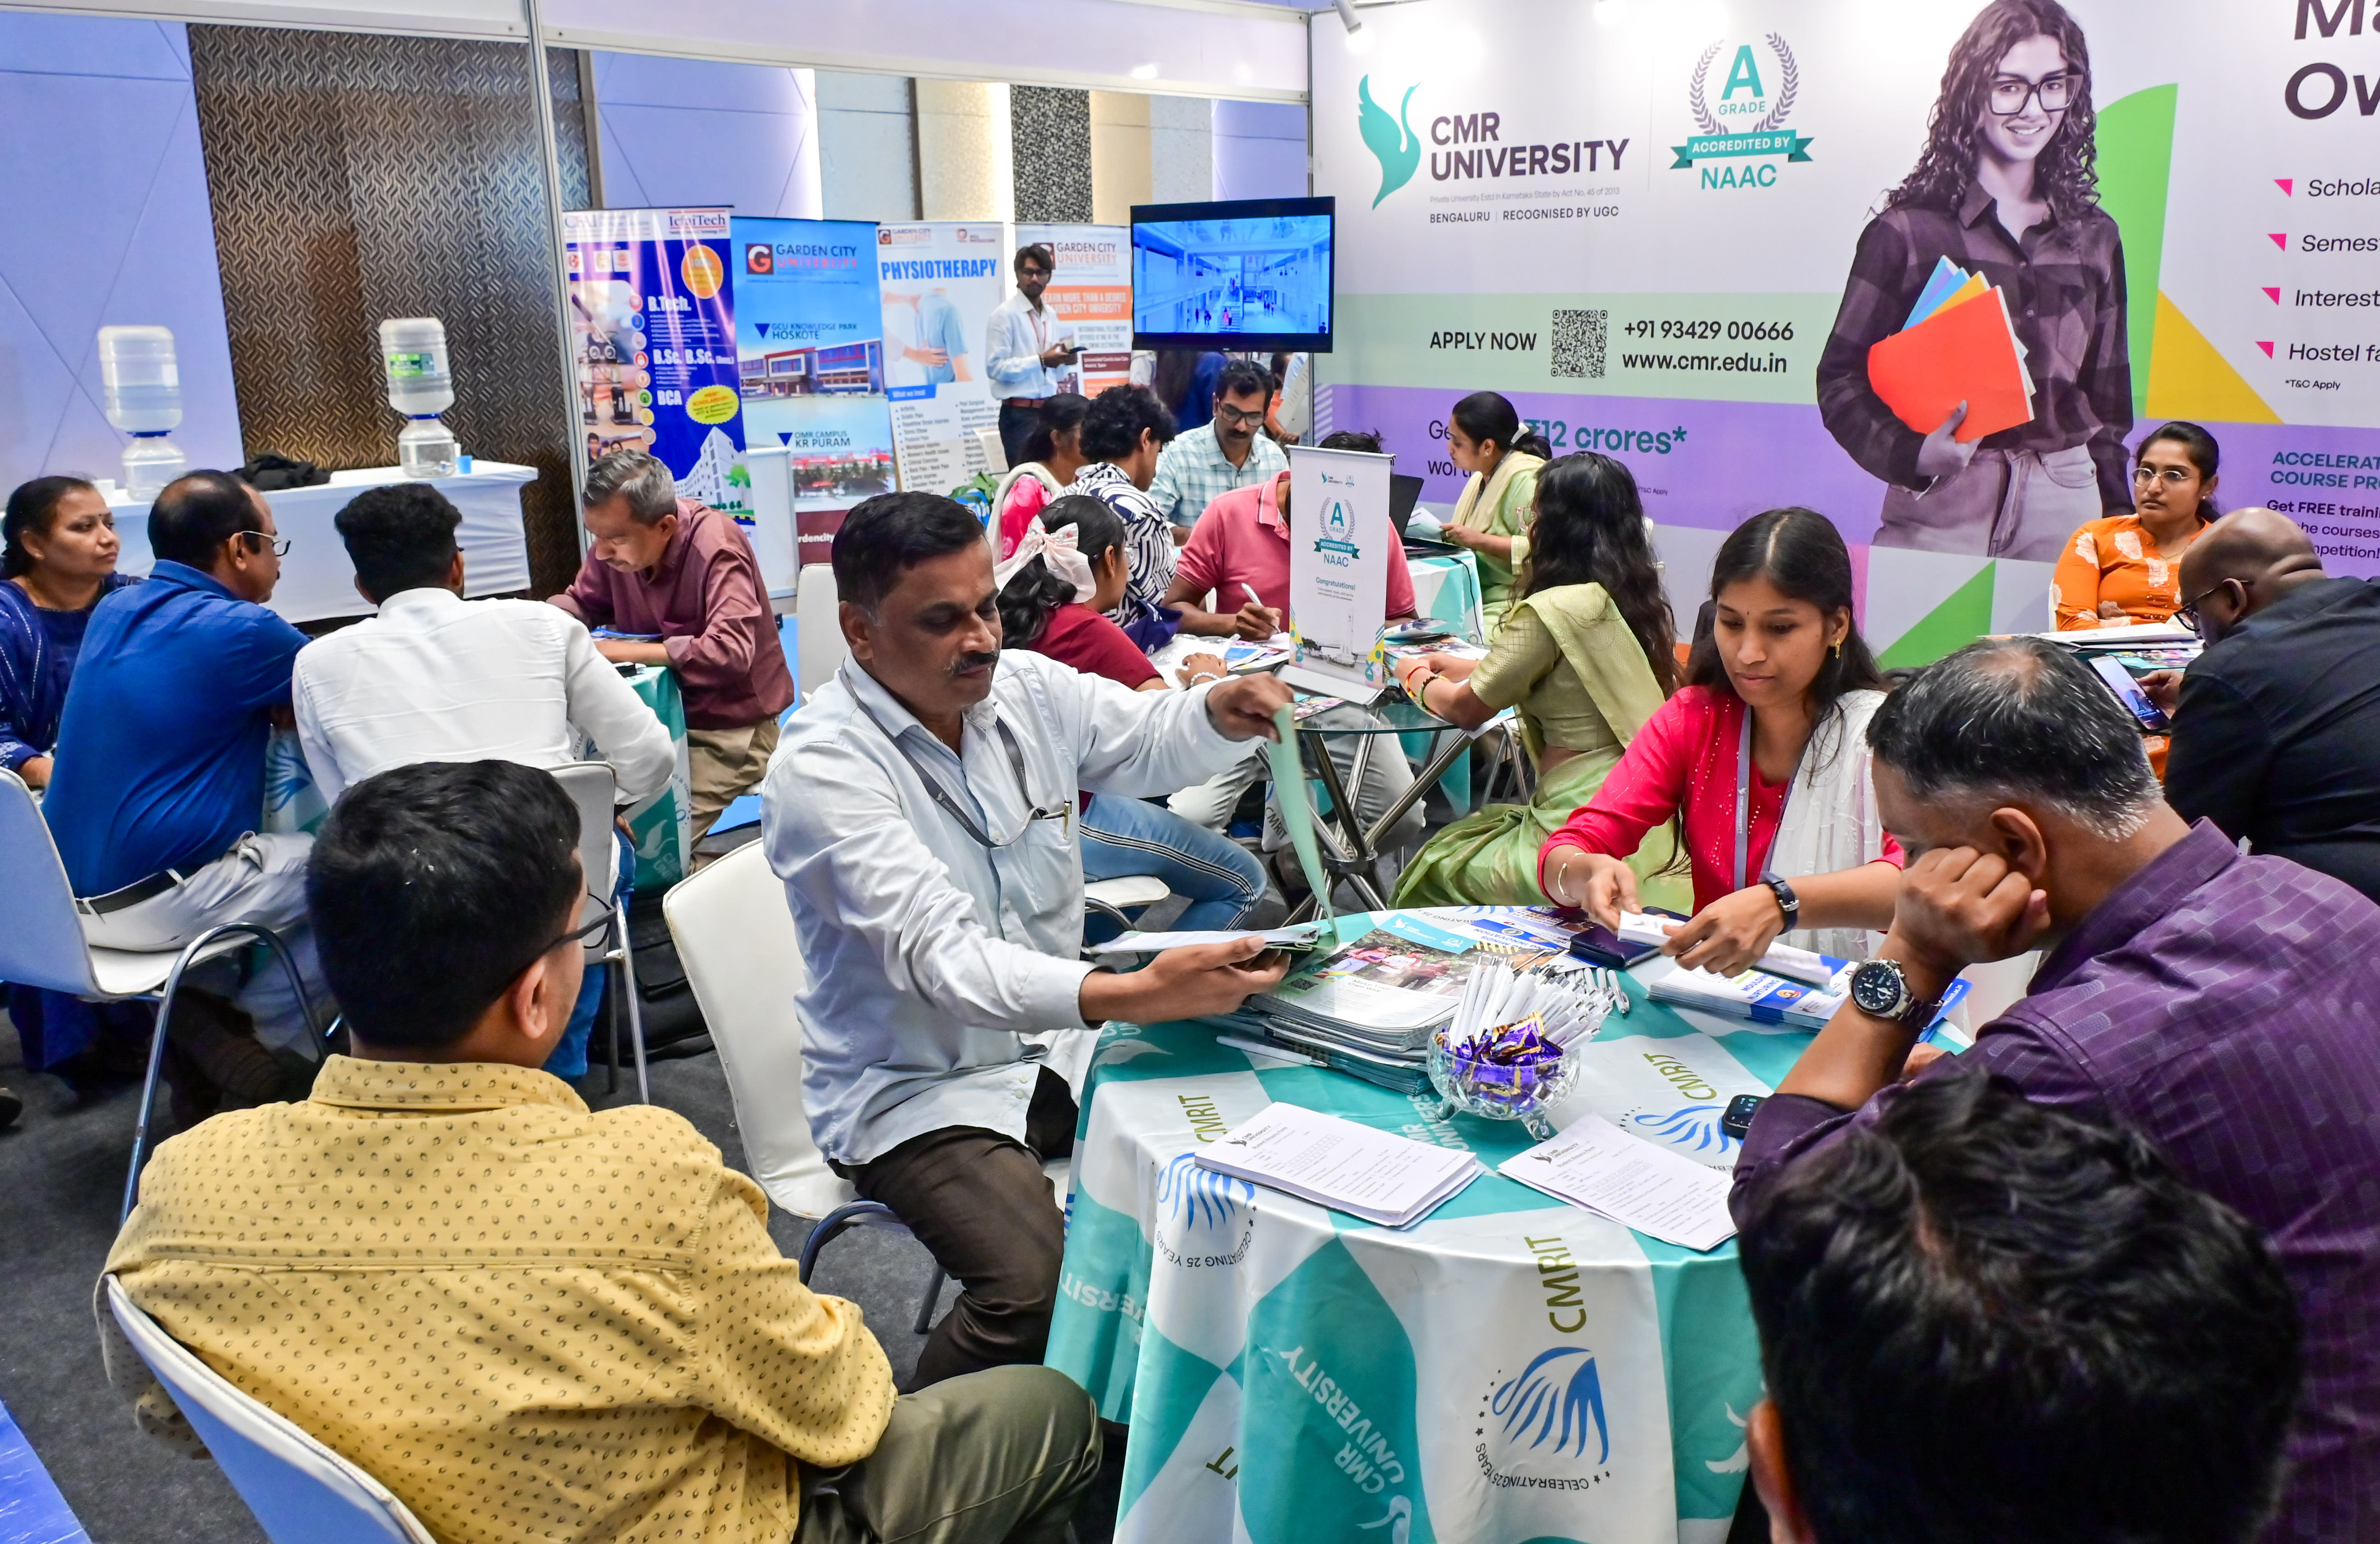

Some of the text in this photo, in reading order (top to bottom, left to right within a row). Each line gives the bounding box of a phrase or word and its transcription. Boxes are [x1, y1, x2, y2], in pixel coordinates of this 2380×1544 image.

[2294, 0, 2380, 40] M
[1721, 45, 1764, 100] A
[1719, 101, 1765, 115] GRADE
[1431, 111, 1500, 146] CMR
[1692, 137, 1790, 153] ACCREDITED BY
[1431, 138, 1630, 181] UNIVERSITY
[1700, 164, 1776, 190] NAAC
[1451, 194, 1479, 203] University
[1502, 191, 1533, 200] Karnataka
[1534, 190, 1551, 199] State
[1553, 190, 1560, 198] by
[1430, 212, 1490, 223] BENGALURU
[1503, 206, 1619, 221] RECOGNISED BY UGC
[777, 244, 856, 257] GARDEN CITY
[1057, 242, 1116, 253] GARDEN CITY
[2301, 235, 2380, 252] Semes
[777, 257, 857, 269] UNIVERSITY
[1058, 254, 1117, 264] UNIVERSITY
[881, 259, 997, 280] PHYSIOTHERAPY
[648, 296, 692, 311] B.Tech.
[1073, 304, 1087, 313] CITY
[1089, 303, 1122, 313] UNIVERSITY
[773, 331, 819, 340] HOSKOTE
[1624, 321, 1793, 341] +91 93429 00666
[1429, 332, 1537, 351] APPLY NOW
[2289, 343, 2360, 361] Hostel
[1622, 352, 1787, 373] www.cmr.edu.in
[2312, 380, 2341, 391] Apply
[657, 390, 682, 406] BCA
[795, 438, 850, 448] KR PURAM
[2272, 451, 2380, 470] ACCELERAT
[2271, 471, 2380, 490] COURSE PR
[1330, 502, 1344, 527] A
[2266, 500, 2380, 519] Get FREE traini
[798, 533, 834, 543] rdencity
[2322, 526, 2380, 539] courses
[1320, 541, 1347, 550] ACCREDITED
[2314, 545, 2380, 559] petition!
[1324, 553, 1349, 567] NAAC
[1316, 577, 1355, 590] Congratulations!
[1266, 807, 1288, 840] CMRIT
[1474, 928, 1528, 946] INNOVATION
[1481, 936, 1510, 946] MINDS
[1741, 973, 1769, 992] MOULDIN
[1746, 979, 1780, 1000] NURTURING
[1643, 1053, 1717, 1100] CMRIT
[1402, 1123, 1436, 1145] MR
[1553, 1142, 1579, 1158] UNIVERSITY
[1156, 1231, 1182, 1267] YEARS
[1187, 1257, 1201, 1267] 25
[1524, 1236, 1587, 1333] CMRIT
[1279, 1346, 1405, 1484] UNIVERSITY
[1335, 1441, 1385, 1493] CMR
[1476, 1443, 1495, 1481] YEARS
[1502, 1476, 1589, 1490] CELEBRATING
